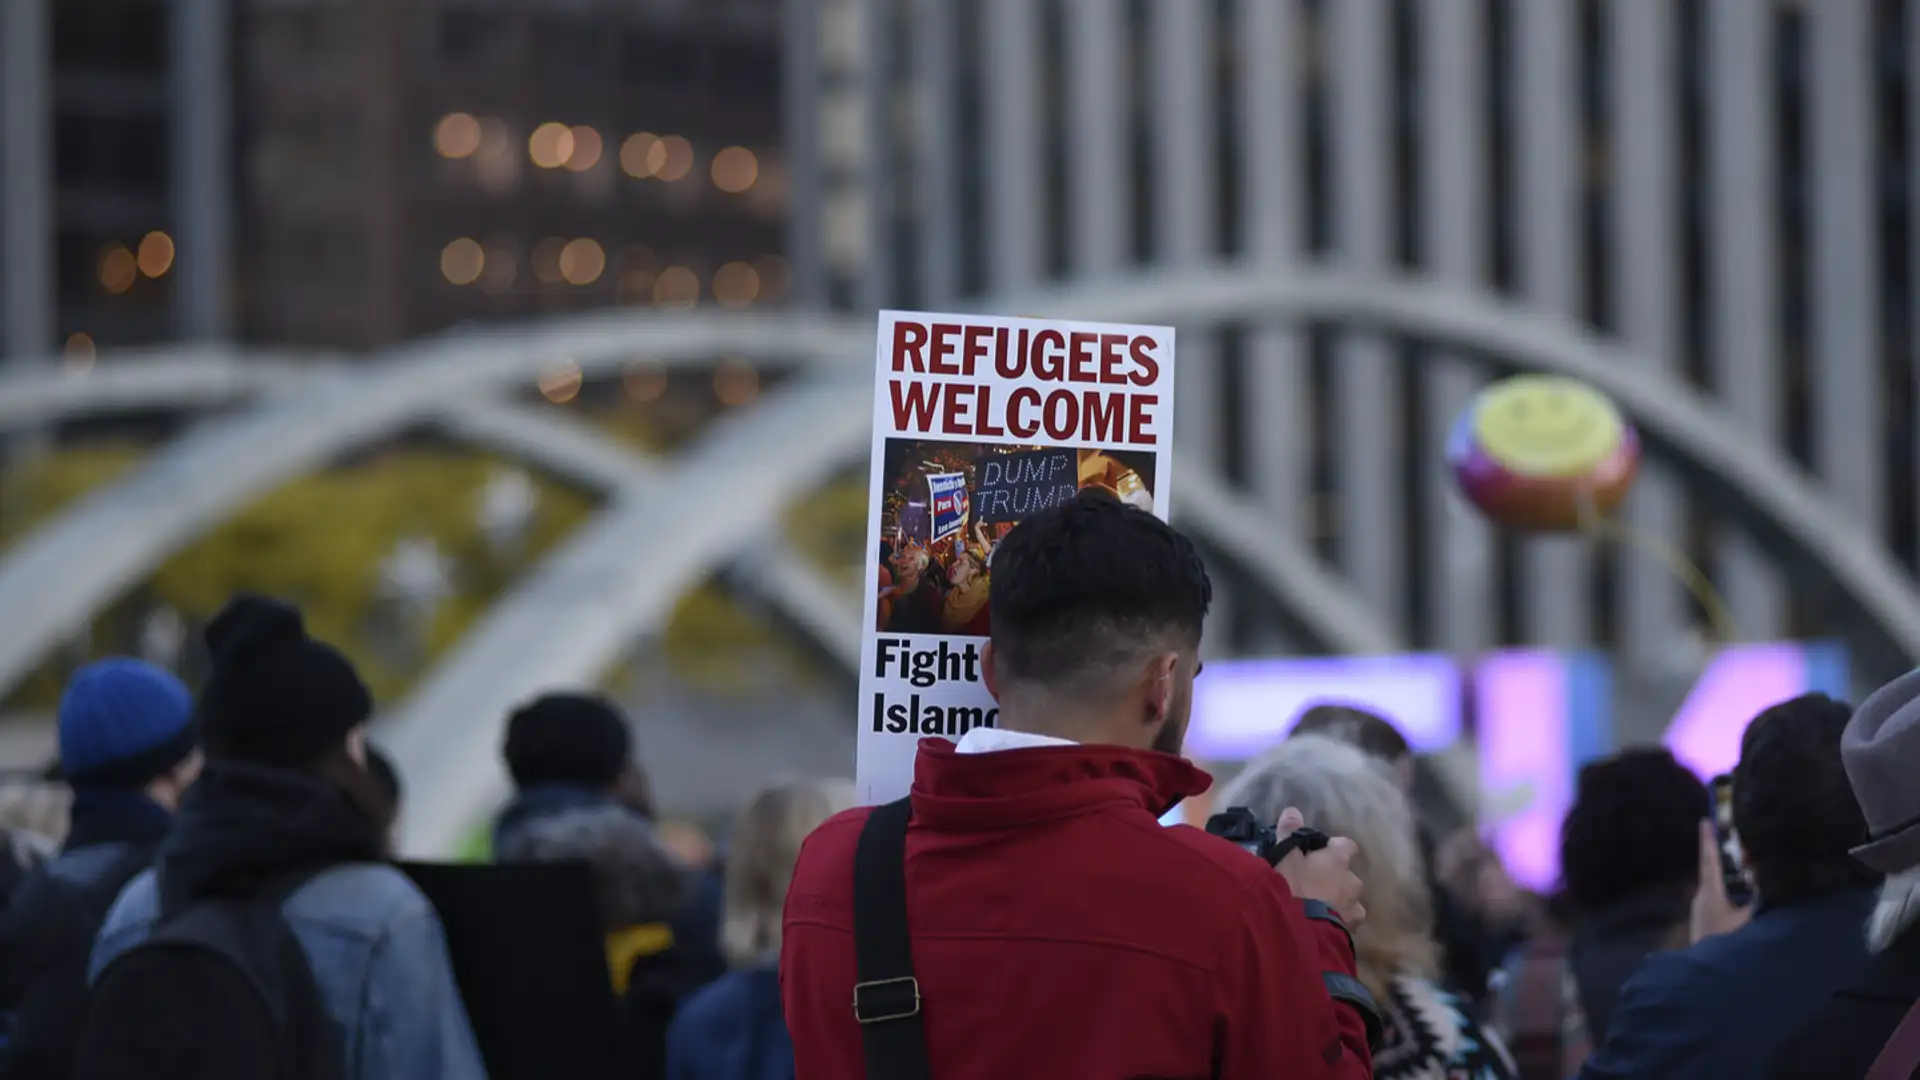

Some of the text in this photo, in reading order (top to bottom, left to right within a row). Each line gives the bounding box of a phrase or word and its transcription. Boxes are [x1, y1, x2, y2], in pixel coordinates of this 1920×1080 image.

[891, 321, 1160, 387] REFUGEES
[889, 380, 1159, 445] WELCOME
[983, 455, 1068, 486] DUMP
[977, 484, 1076, 515] TRUMP
[875, 638, 979, 687] Fight
